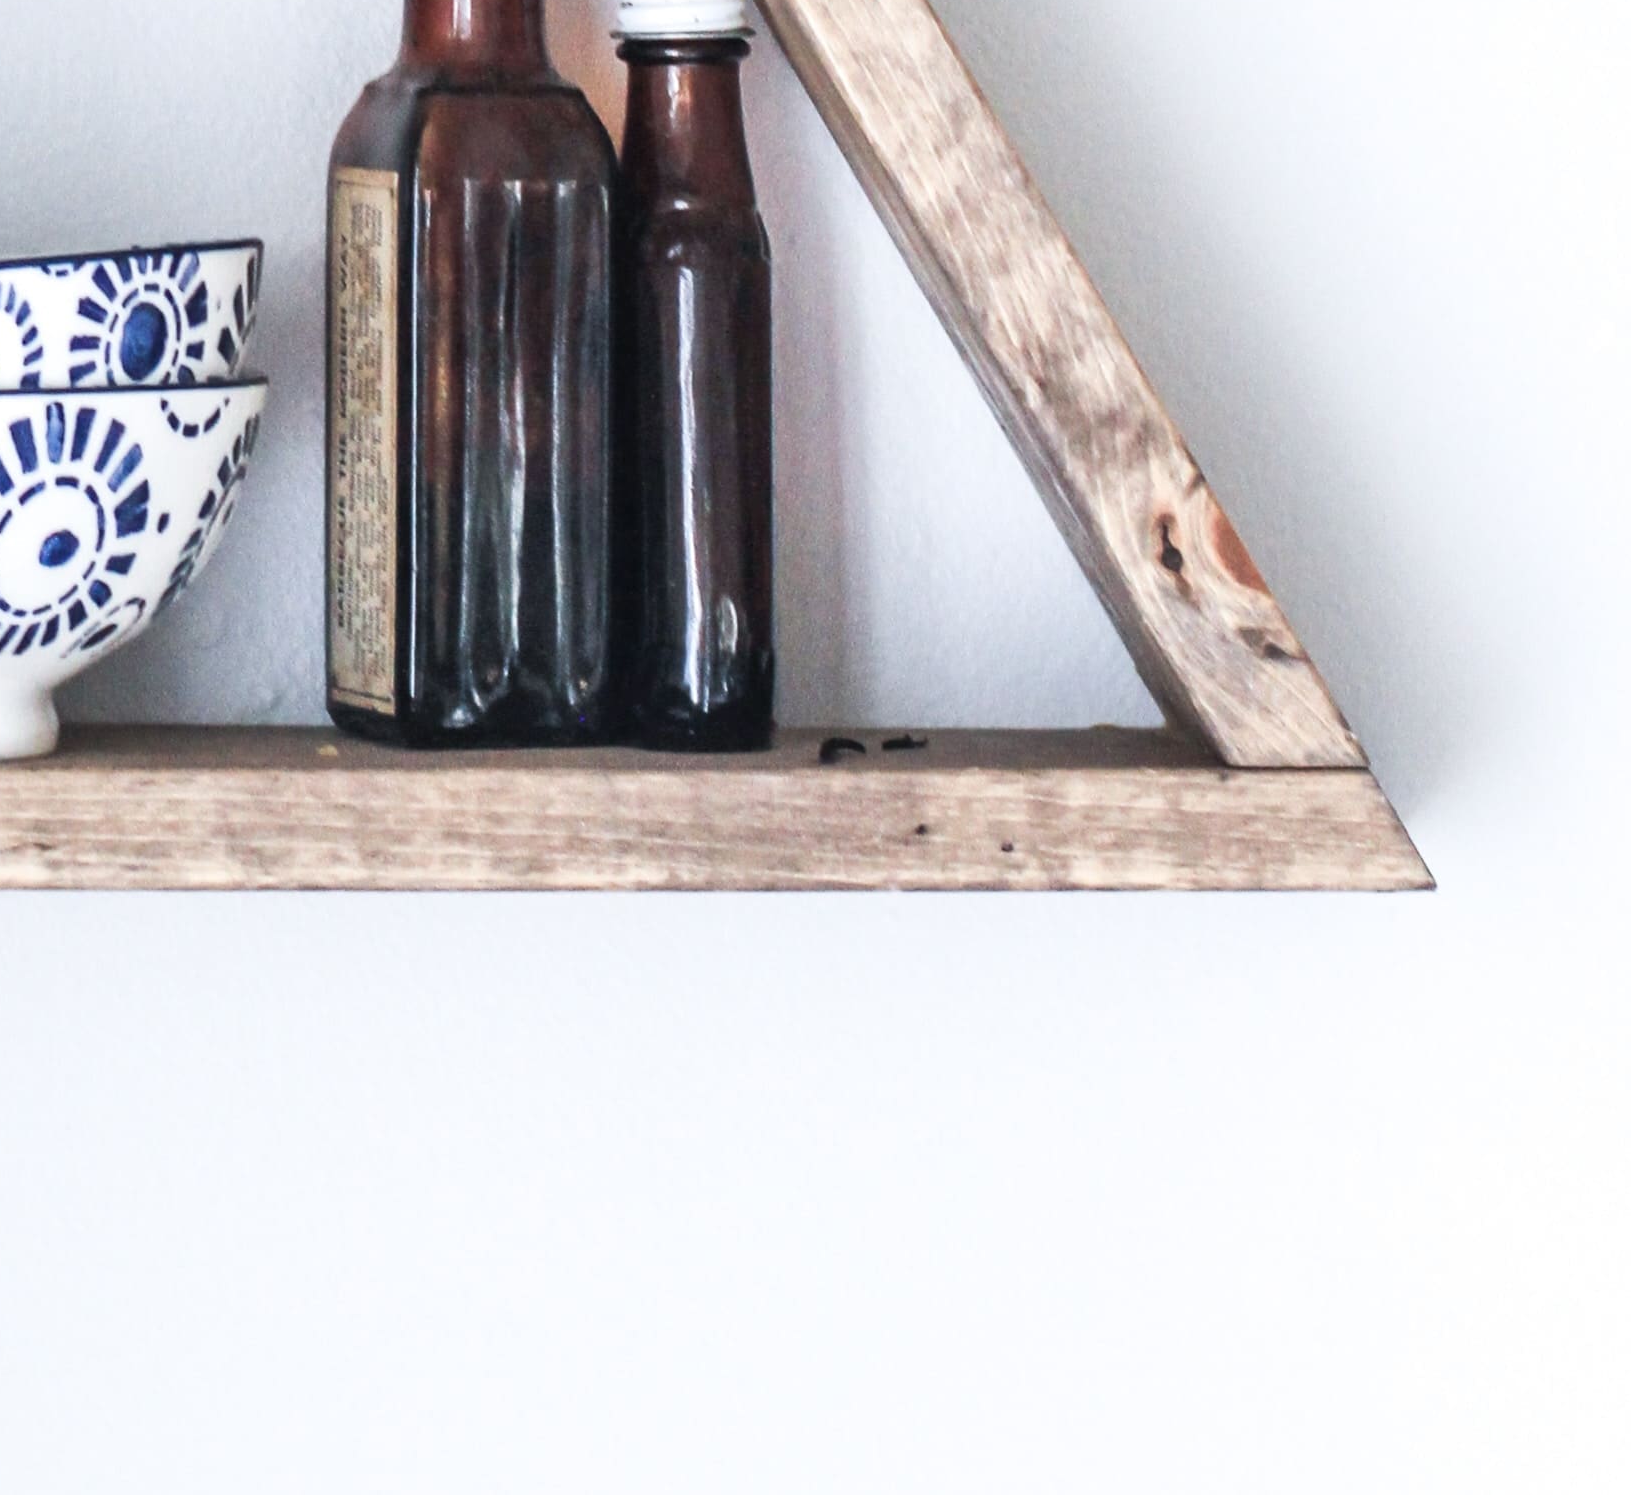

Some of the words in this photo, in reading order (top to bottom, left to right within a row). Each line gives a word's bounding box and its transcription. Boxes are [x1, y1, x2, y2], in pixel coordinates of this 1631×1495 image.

[339, 234, 348, 292] WAY
[339, 307, 348, 418] MODERN
[338, 434, 347, 478] THE
[337, 497, 346, 628] BARBECUE
